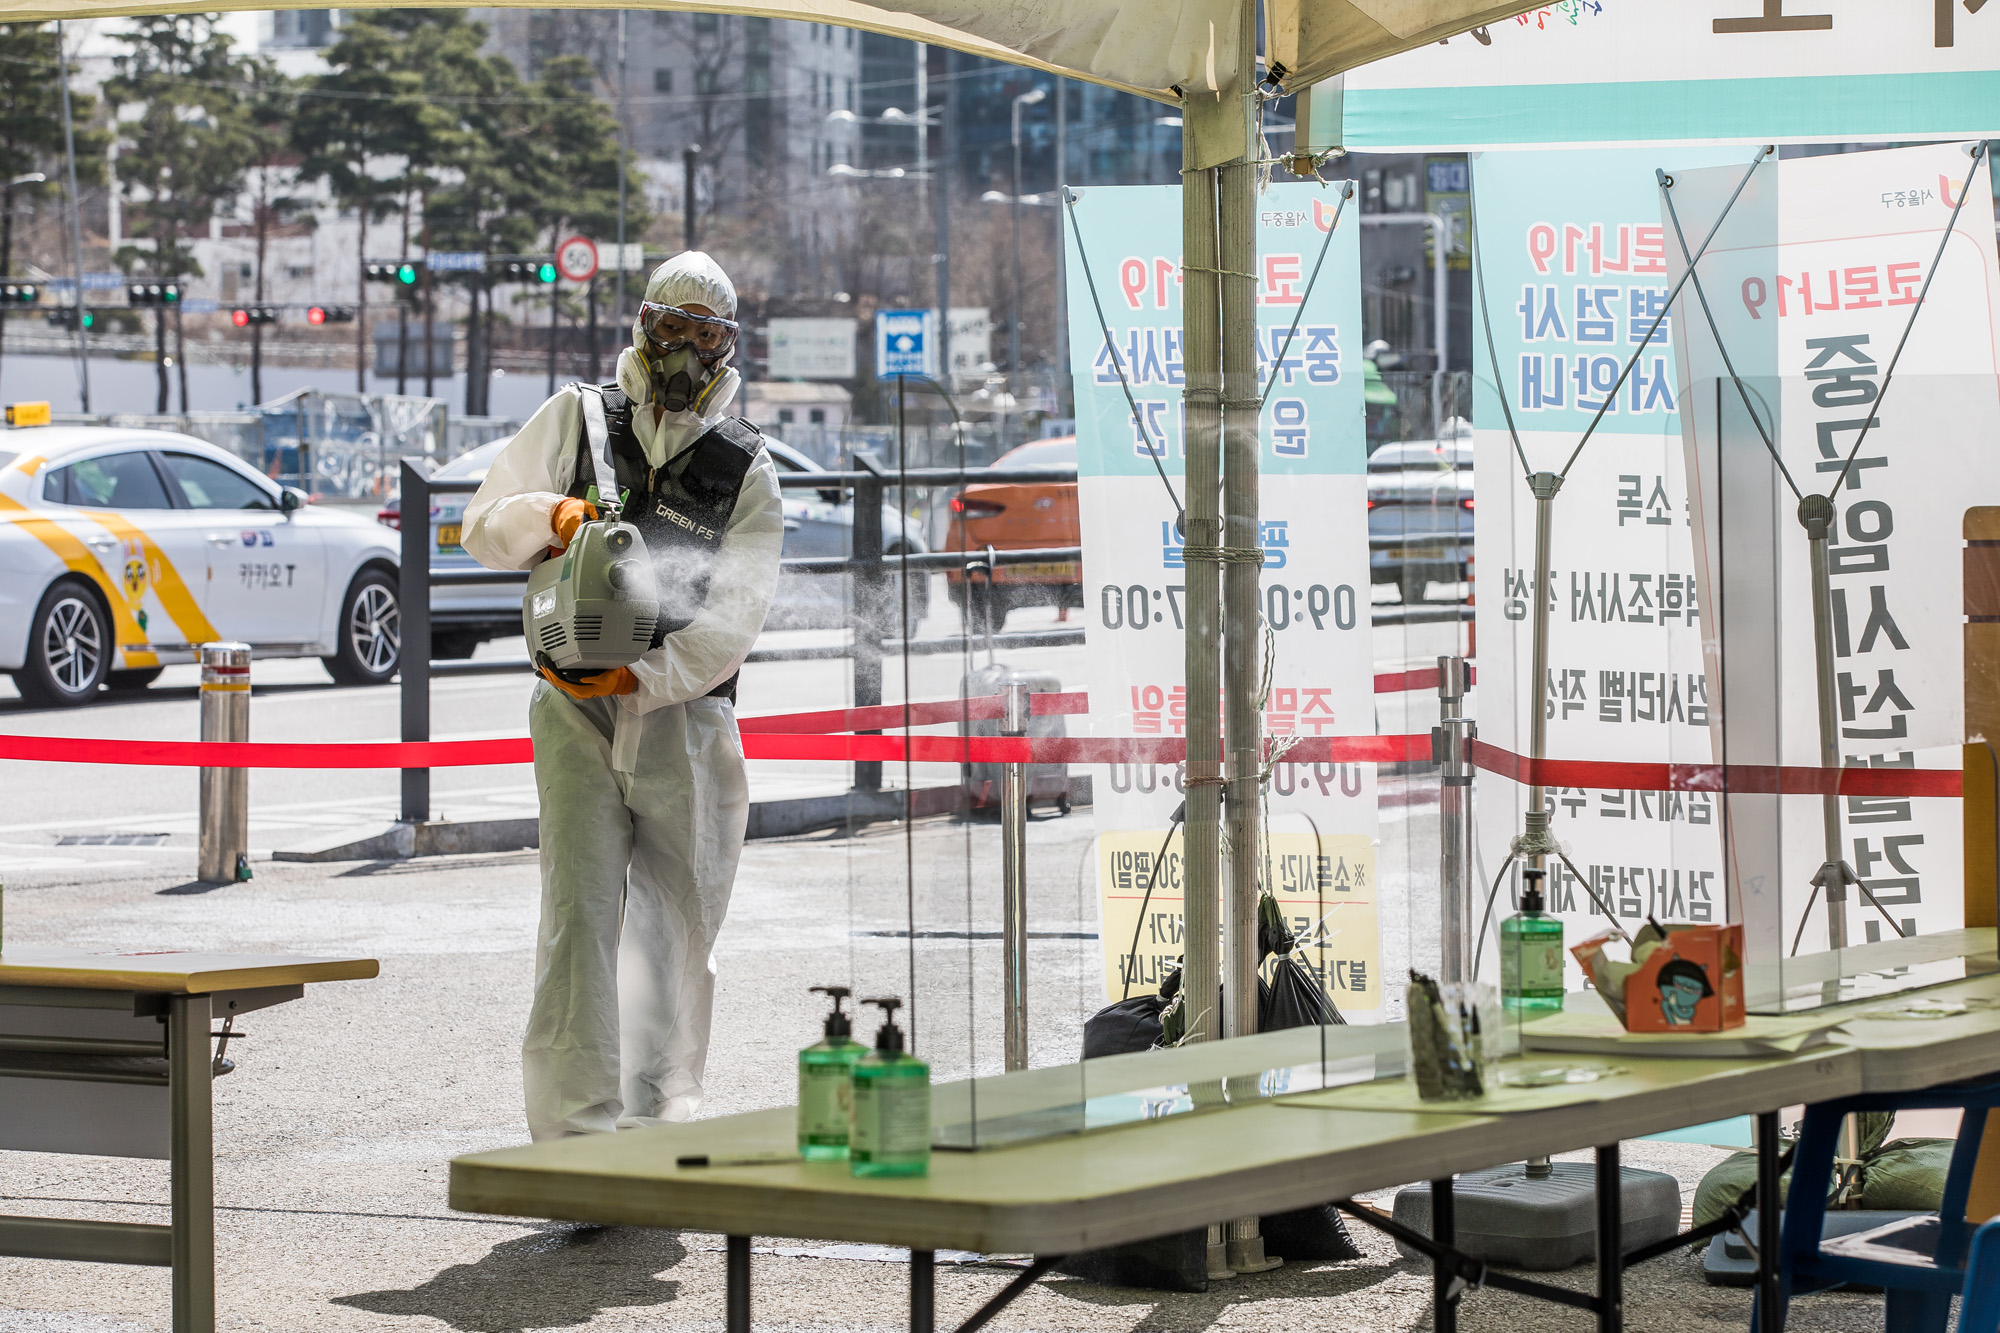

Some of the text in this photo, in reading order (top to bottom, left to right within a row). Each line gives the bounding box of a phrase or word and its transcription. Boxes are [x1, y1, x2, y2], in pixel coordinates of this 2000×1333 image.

[566, 252, 590, 270] 50
[656, 504, 696, 532] GREEN
[285, 563, 297, 588] T
